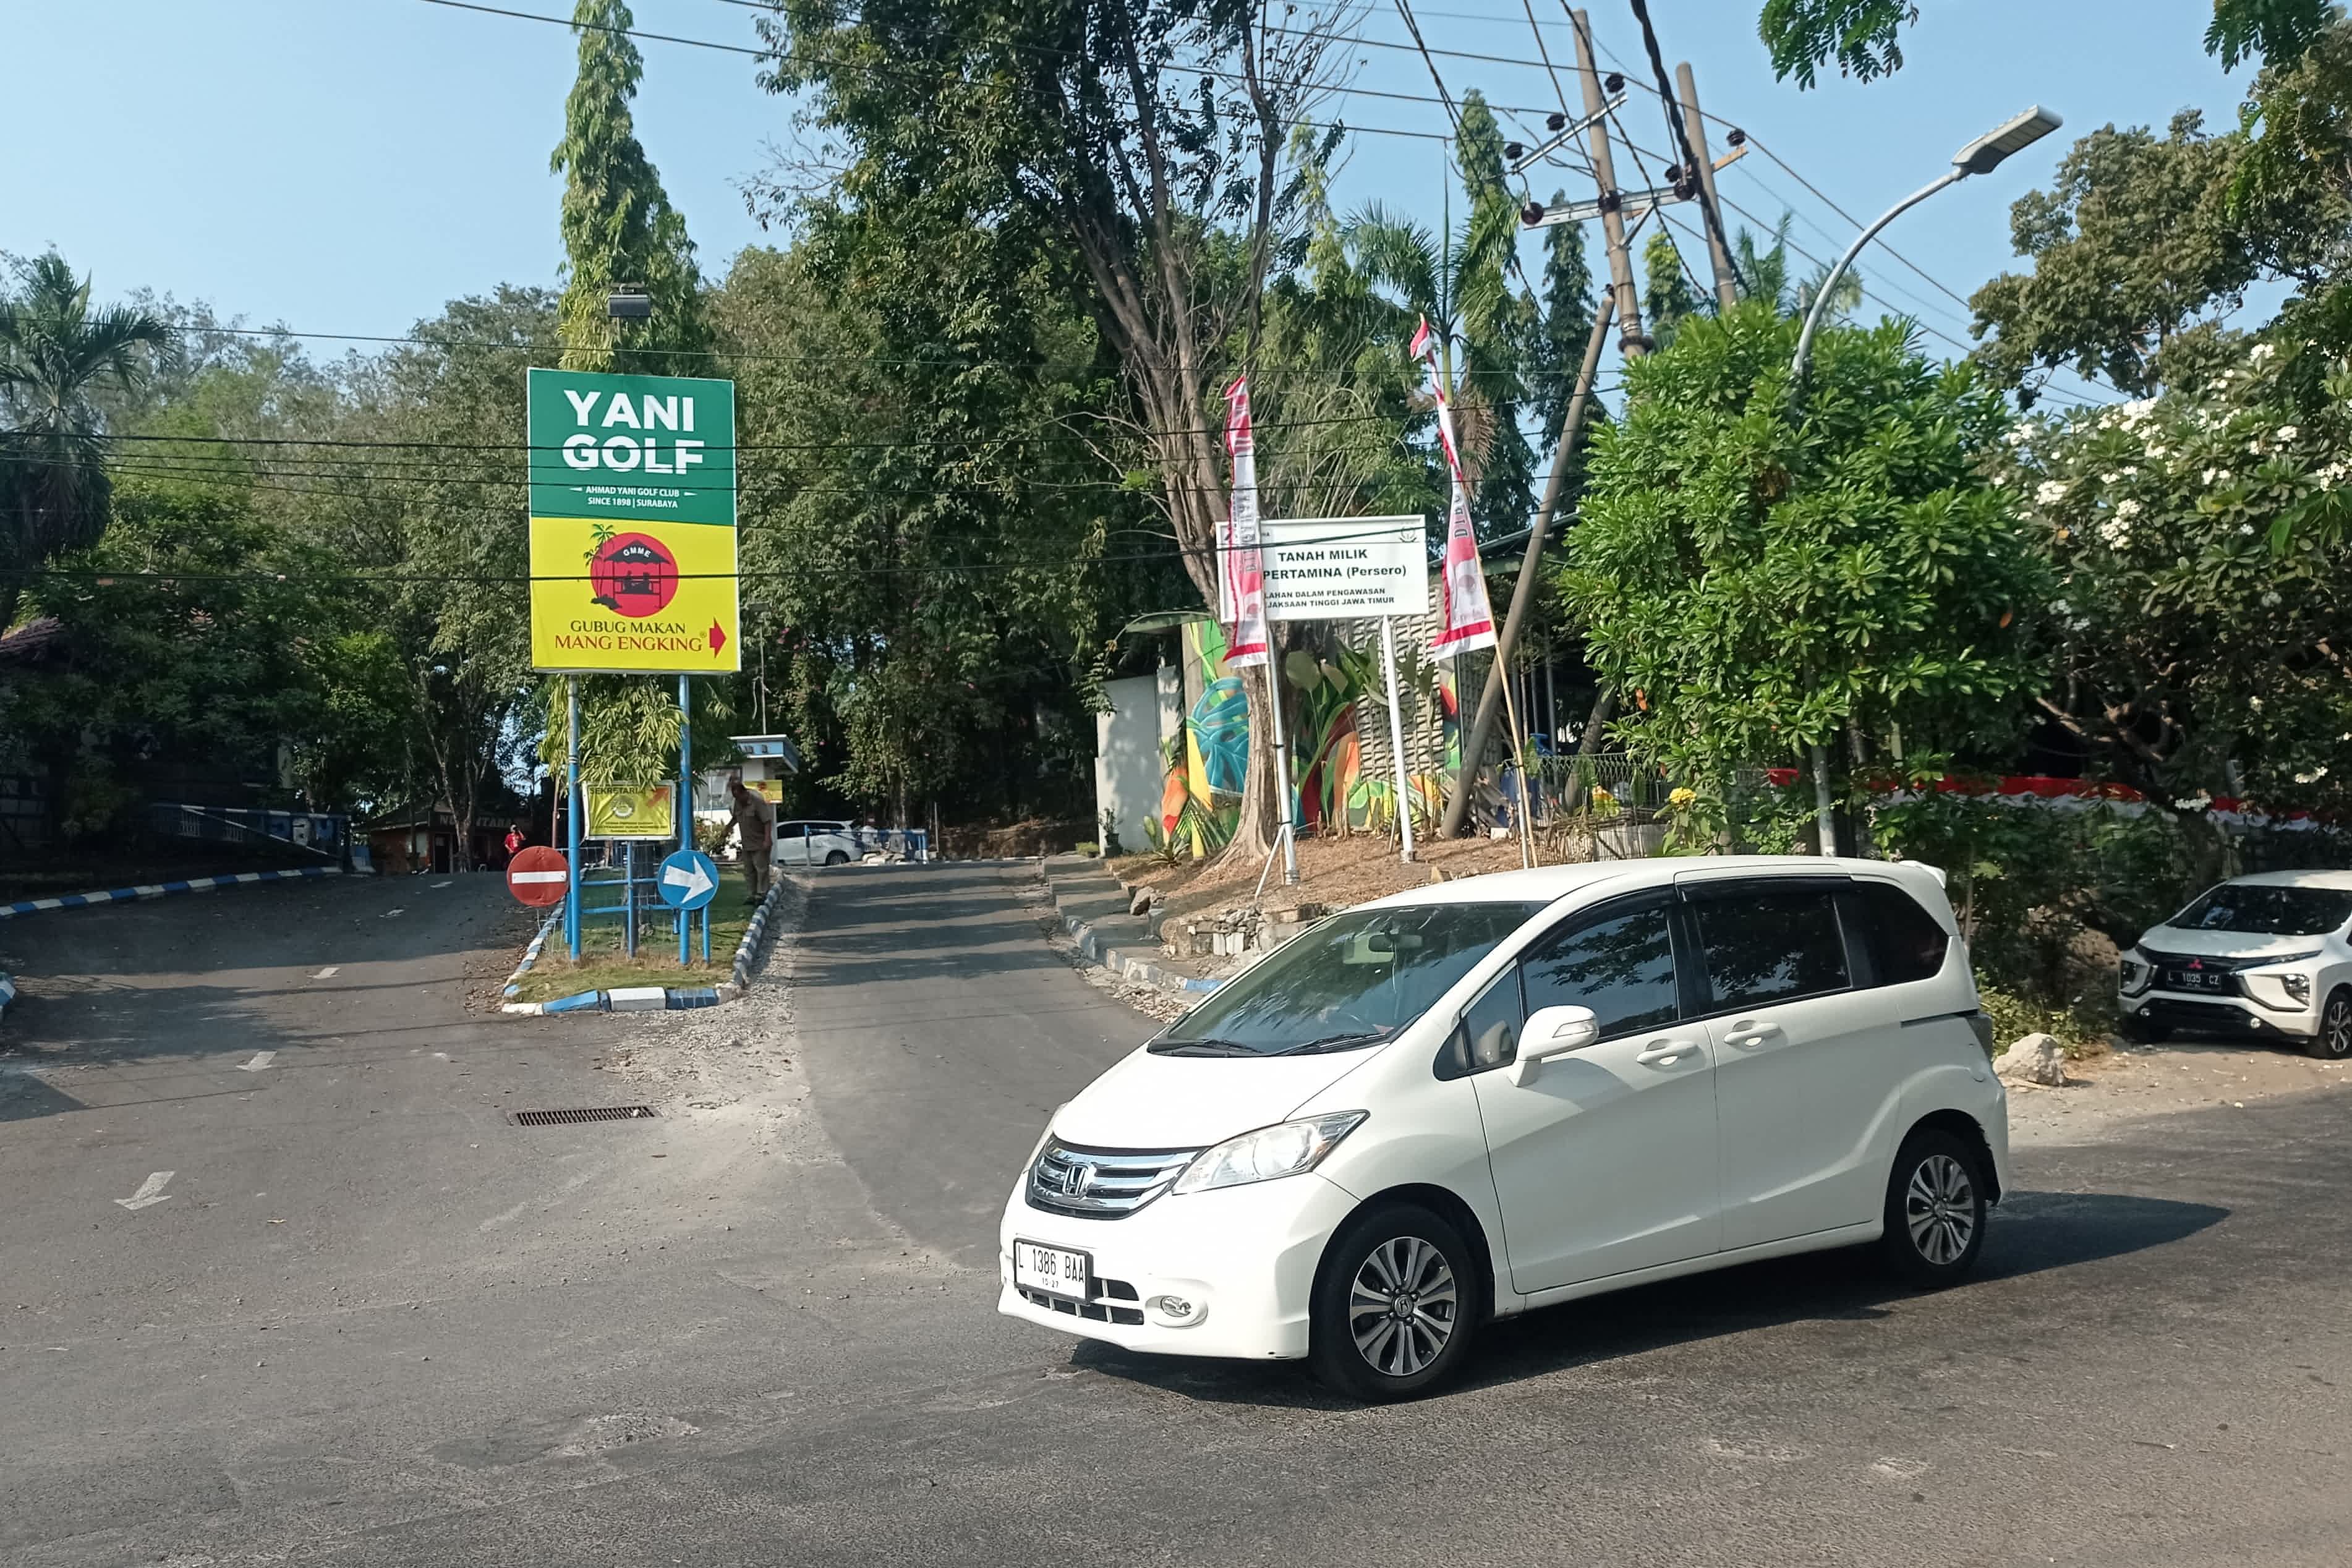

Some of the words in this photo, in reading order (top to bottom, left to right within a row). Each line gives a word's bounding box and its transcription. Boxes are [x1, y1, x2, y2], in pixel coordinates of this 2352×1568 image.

[564, 390, 694, 432] YANI
[562, 433, 704, 475] GOLF
[586, 486, 616, 494] AHMAD
[617, 487, 636, 495] YANI
[637, 488, 658, 496] GOLF
[659, 489, 680, 497] CLUB
[588, 497, 611, 505] SINCE
[613, 498, 631, 506] 1898
[636, 499, 678, 508] SURABAYA
[1278, 550, 1324, 562] TANAH
[1329, 549, 1368, 560] MILIK
[1263, 567, 1342, 580] PERTAMINA
[1347, 565, 1406, 579] (Persero)
[1327, 588, 1385, 597] PENGAWASAN
[1368, 597, 1395, 605] TIMUR
[570, 620, 626, 633] GUBUG
[631, 622, 686, 634] MAKAN
[555, 635, 612, 650] MANG
[618, 636, 702, 652] ENGKING
[2168, 970, 2174, 981] L
[1018, 1245, 1024, 1268] L
[1033, 1248, 1056, 1276] 1386
[1065, 1255, 1084, 1284] BAA
